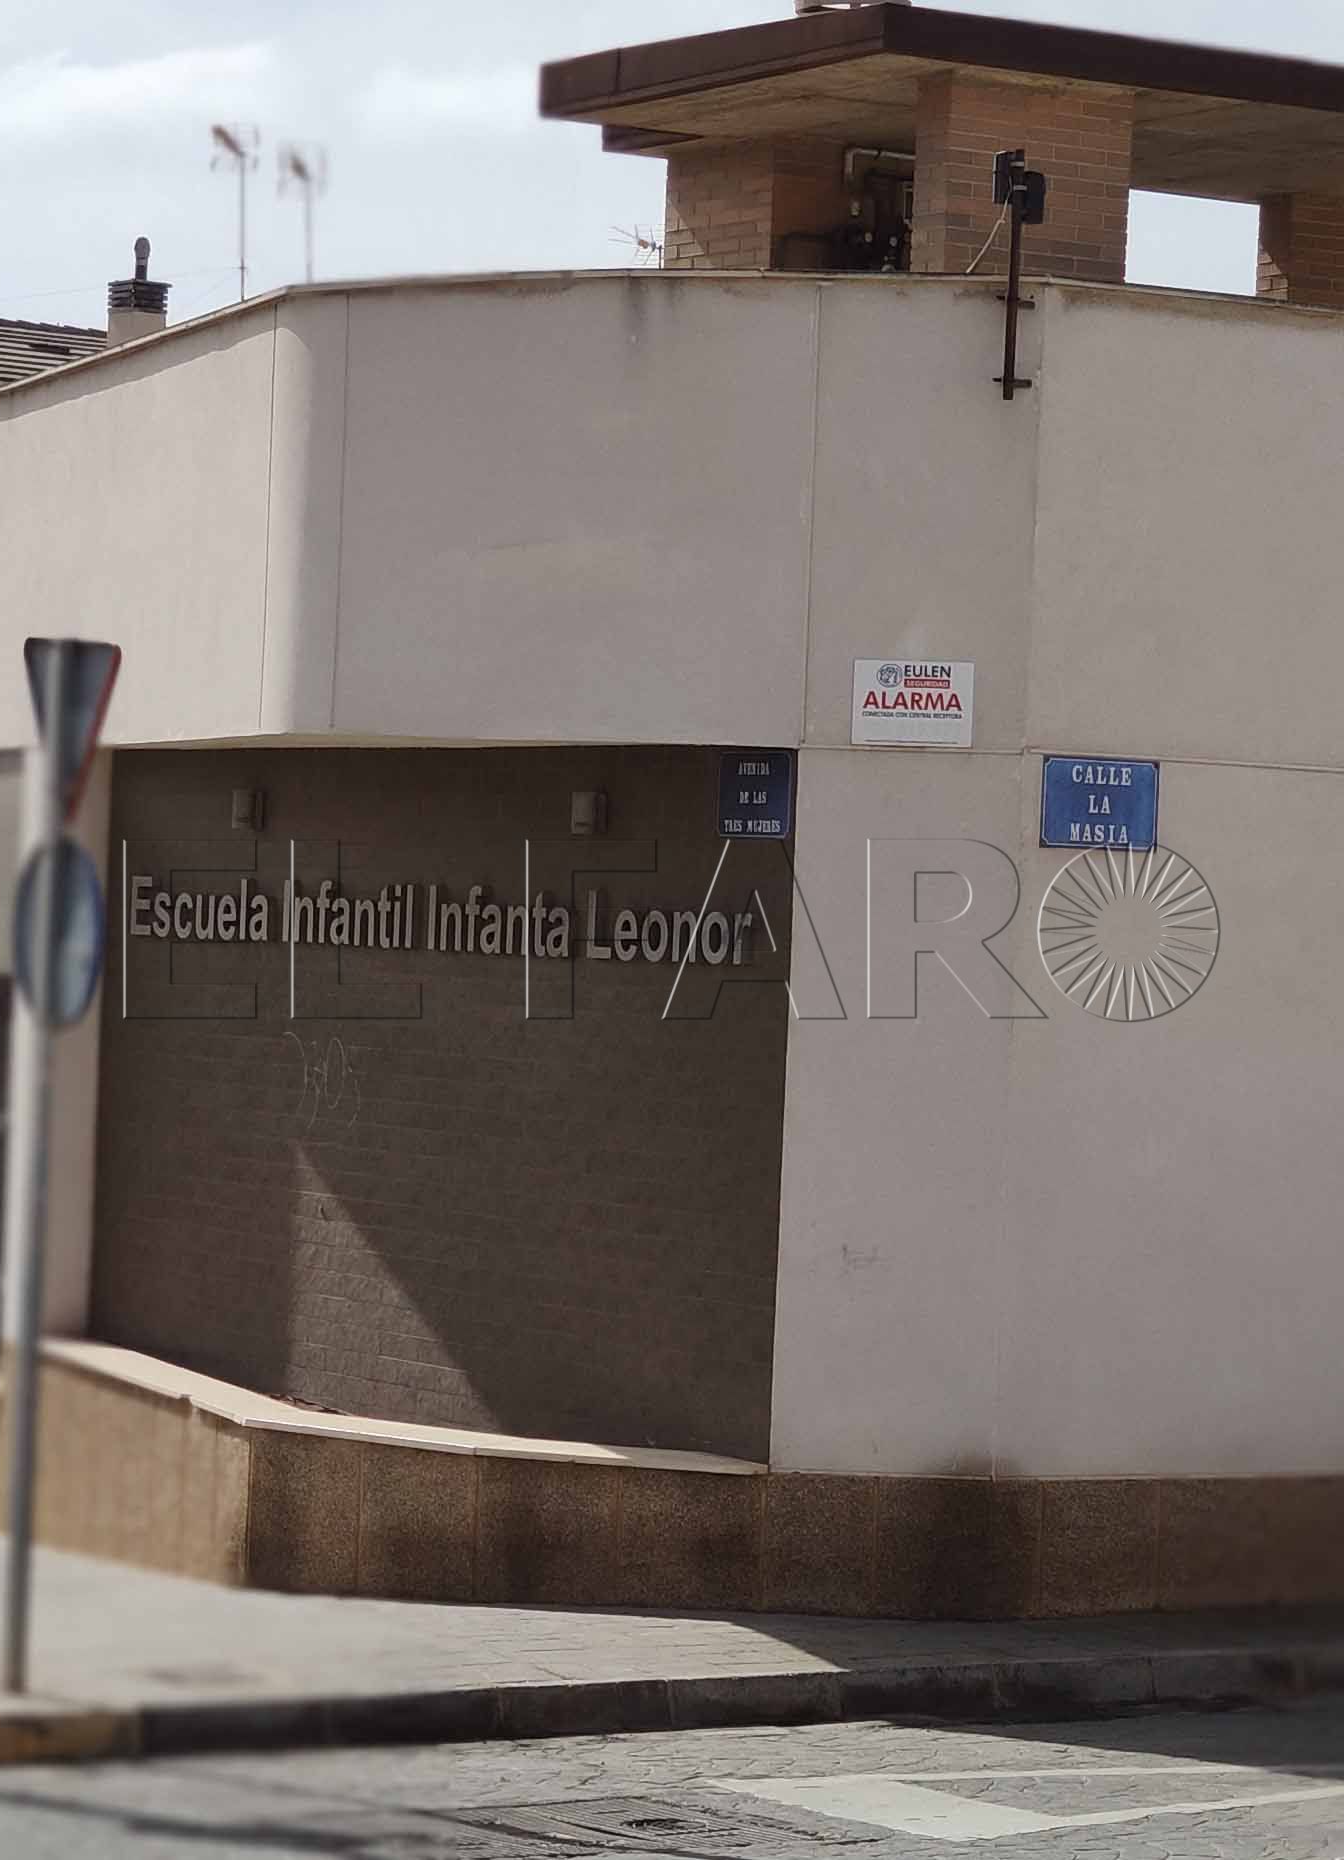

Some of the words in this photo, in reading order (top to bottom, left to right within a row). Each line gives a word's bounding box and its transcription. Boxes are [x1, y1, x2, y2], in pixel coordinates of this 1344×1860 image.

[904, 665, 951, 678] EULEN
[863, 691, 962, 711] ALARMA
[738, 762, 770, 775] AVENIDA
[1072, 765, 1132, 786] CALLE
[739, 791, 749, 804] DE
[753, 791, 767, 804] LAS
[1088, 795, 1111, 814] LA
[724, 819, 742, 832] TRES
[746, 819, 781, 832] MUJERES
[1070, 823, 1128, 843] MASIA
[129, 875, 269, 942] Escuela
[282, 879, 414, 950] Infantil
[427, 884, 570, 959] Infanta
[585, 889, 753, 965] Leonor
